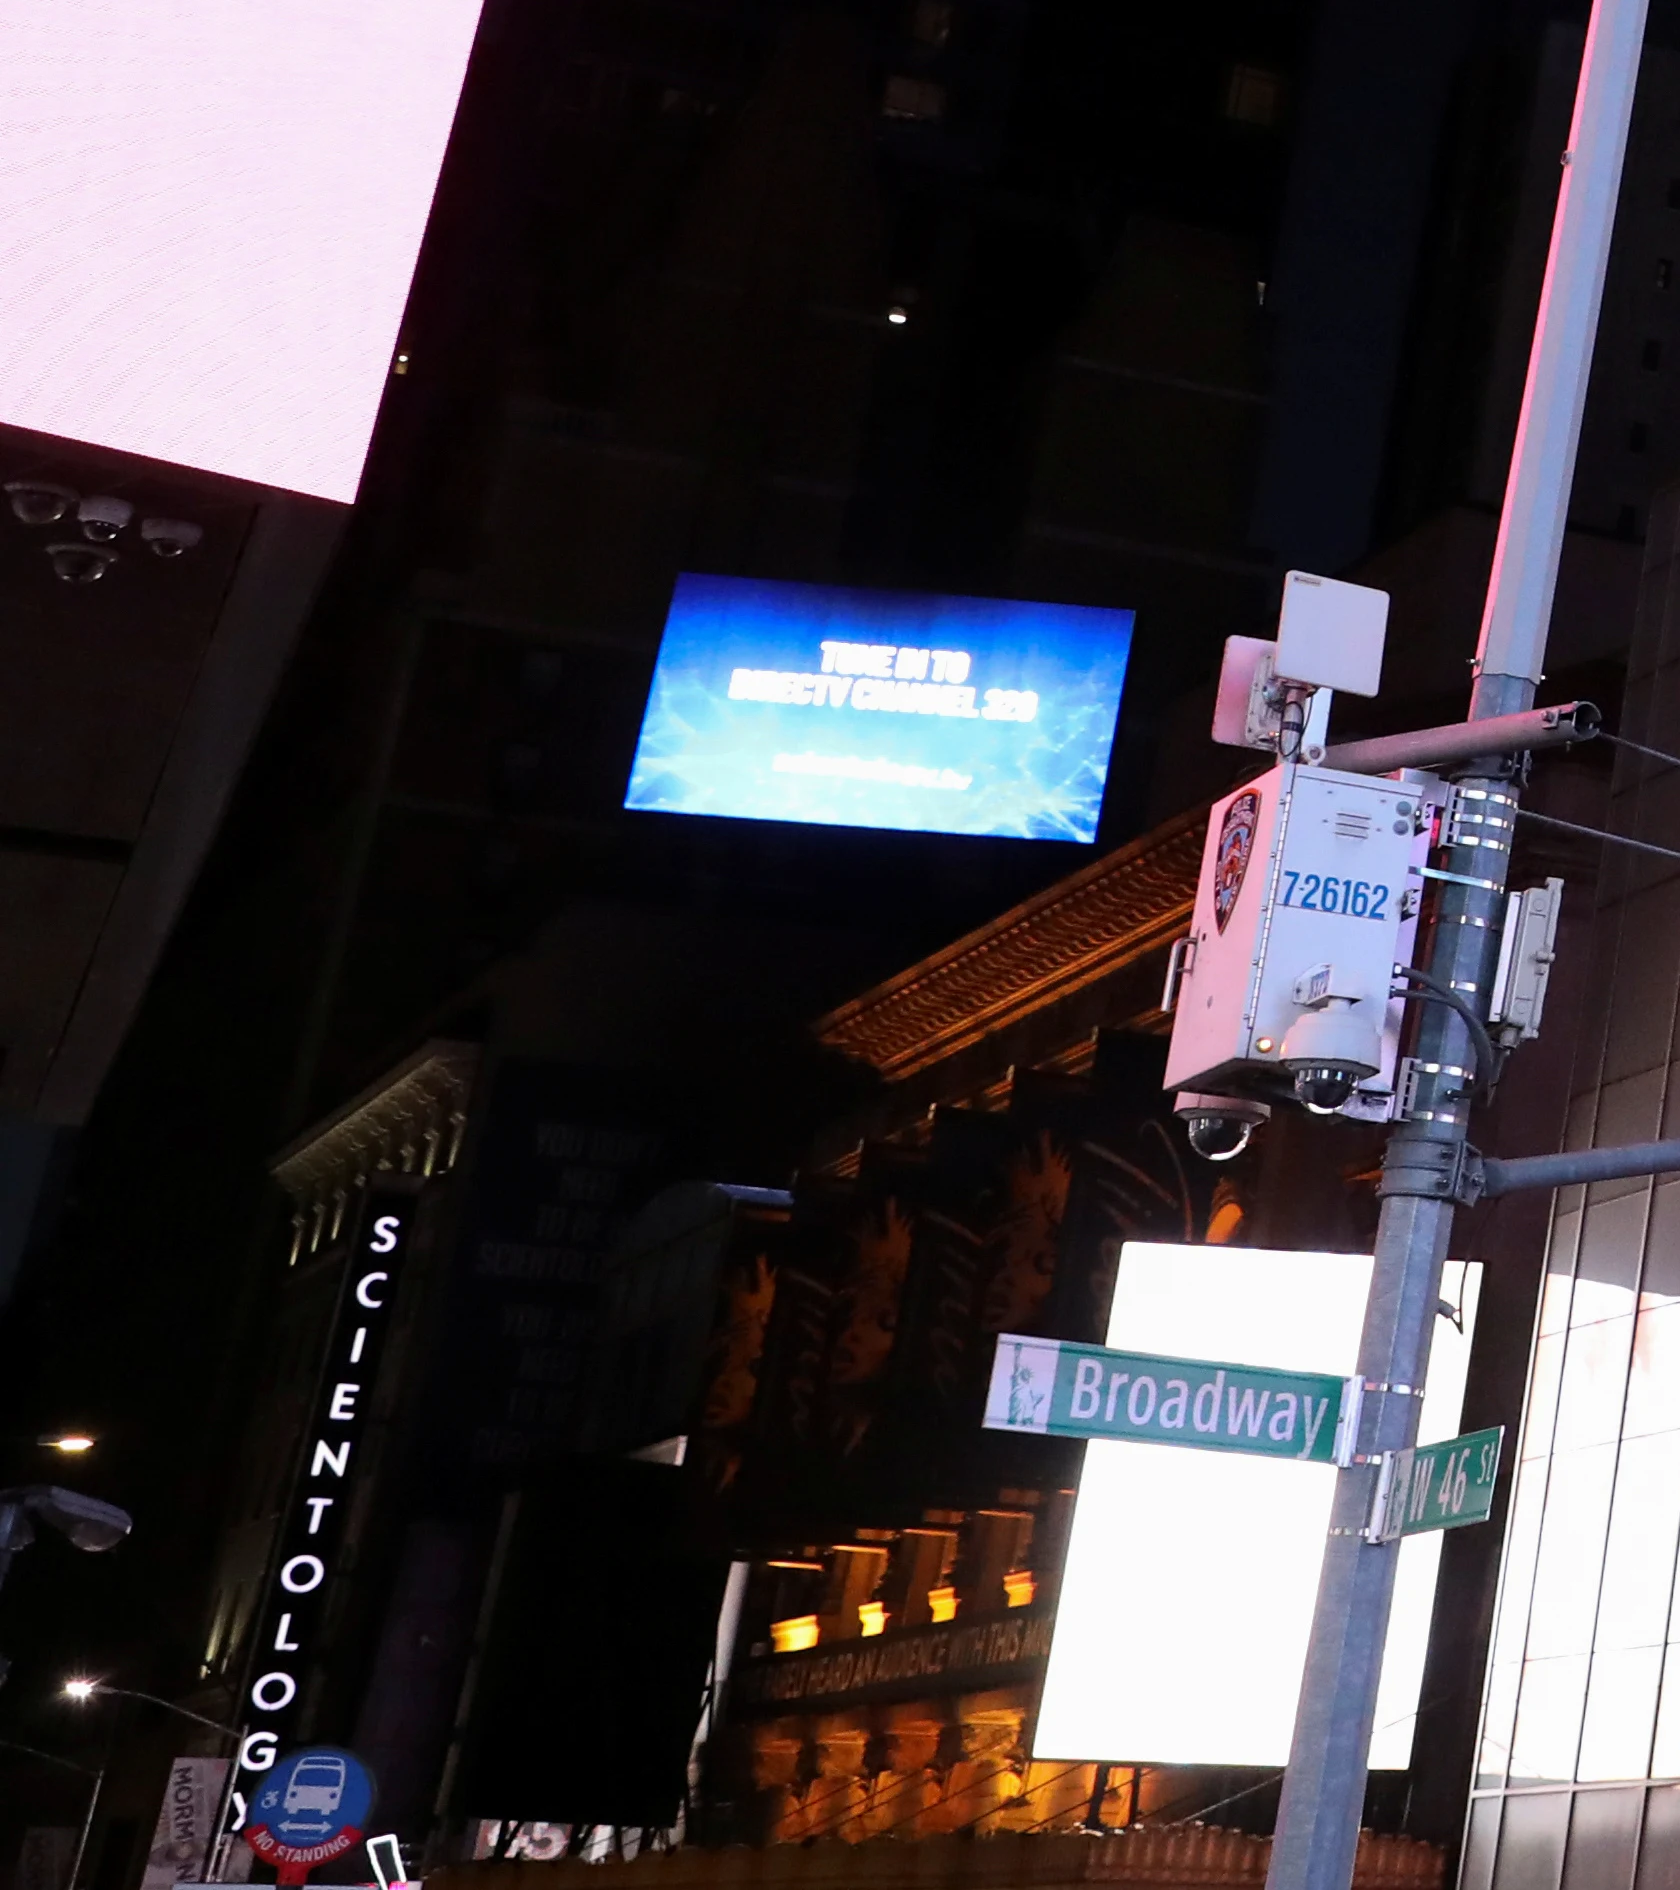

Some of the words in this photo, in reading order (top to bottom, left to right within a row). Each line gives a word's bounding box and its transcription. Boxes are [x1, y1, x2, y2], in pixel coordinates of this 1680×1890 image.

[821, 641, 897, 677] TUNE
[895, 647, 931, 680] IN
[931, 650, 971, 684] TO
[852, 677, 979, 719] CHANNEL
[1069, 1357, 1331, 1462] Broadway
[1408, 1453, 1435, 1522] W
[1437, 1446, 1471, 1519] 46
[1476, 1441, 1498, 1487] St
[252, 1829, 275, 1852] NO
[276, 1833, 352, 1864] STANDING
